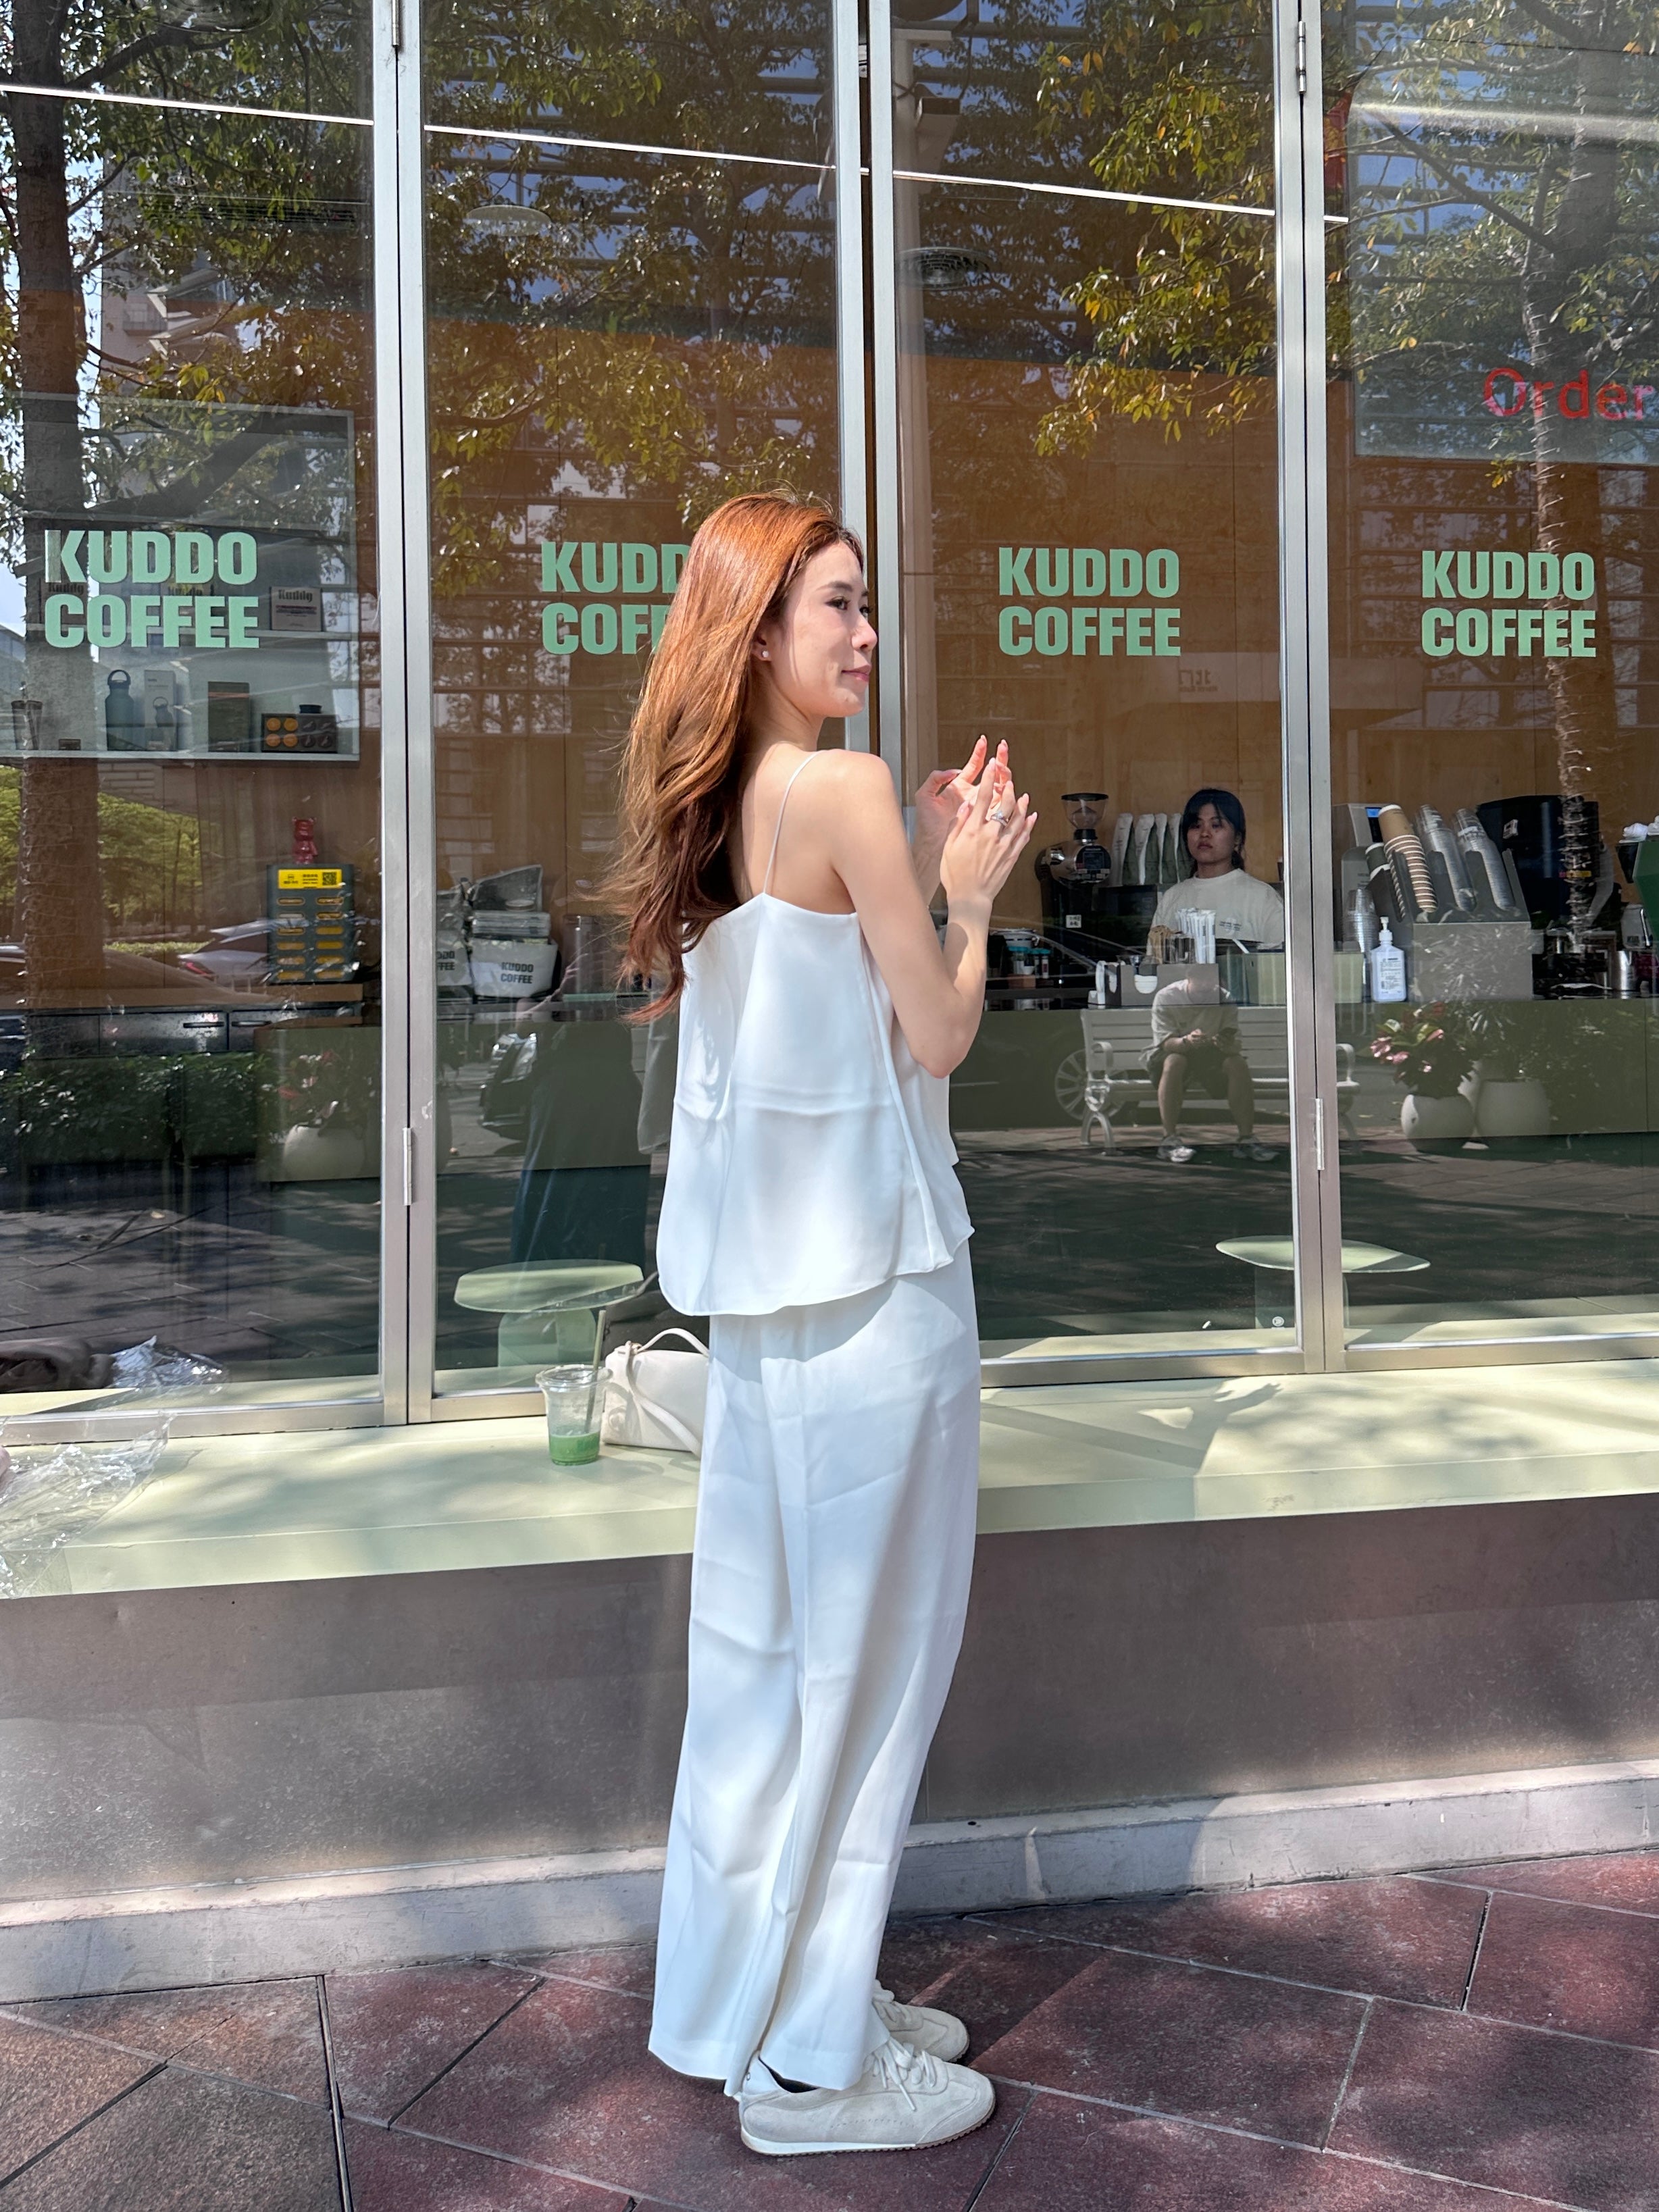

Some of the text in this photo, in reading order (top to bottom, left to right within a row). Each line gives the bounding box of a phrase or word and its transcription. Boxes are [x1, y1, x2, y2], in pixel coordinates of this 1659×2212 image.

[1483, 367, 1654, 420] Order
[45, 530, 257, 585] KUDDO
[541, 541, 692, 593] KUDD
[998, 546, 1179, 598] KUDDO
[1421, 550, 1595, 600] KUDDO
[45, 593, 259, 648] COFFEE
[542, 602, 670, 654] COFF
[998, 606, 1181, 656] COFFEE
[1421, 607, 1596, 657] COFFEE
[436, 950, 455, 959] DDO
[501, 962, 534, 973] KUDDO
[501, 973, 534, 984] COFFEE
